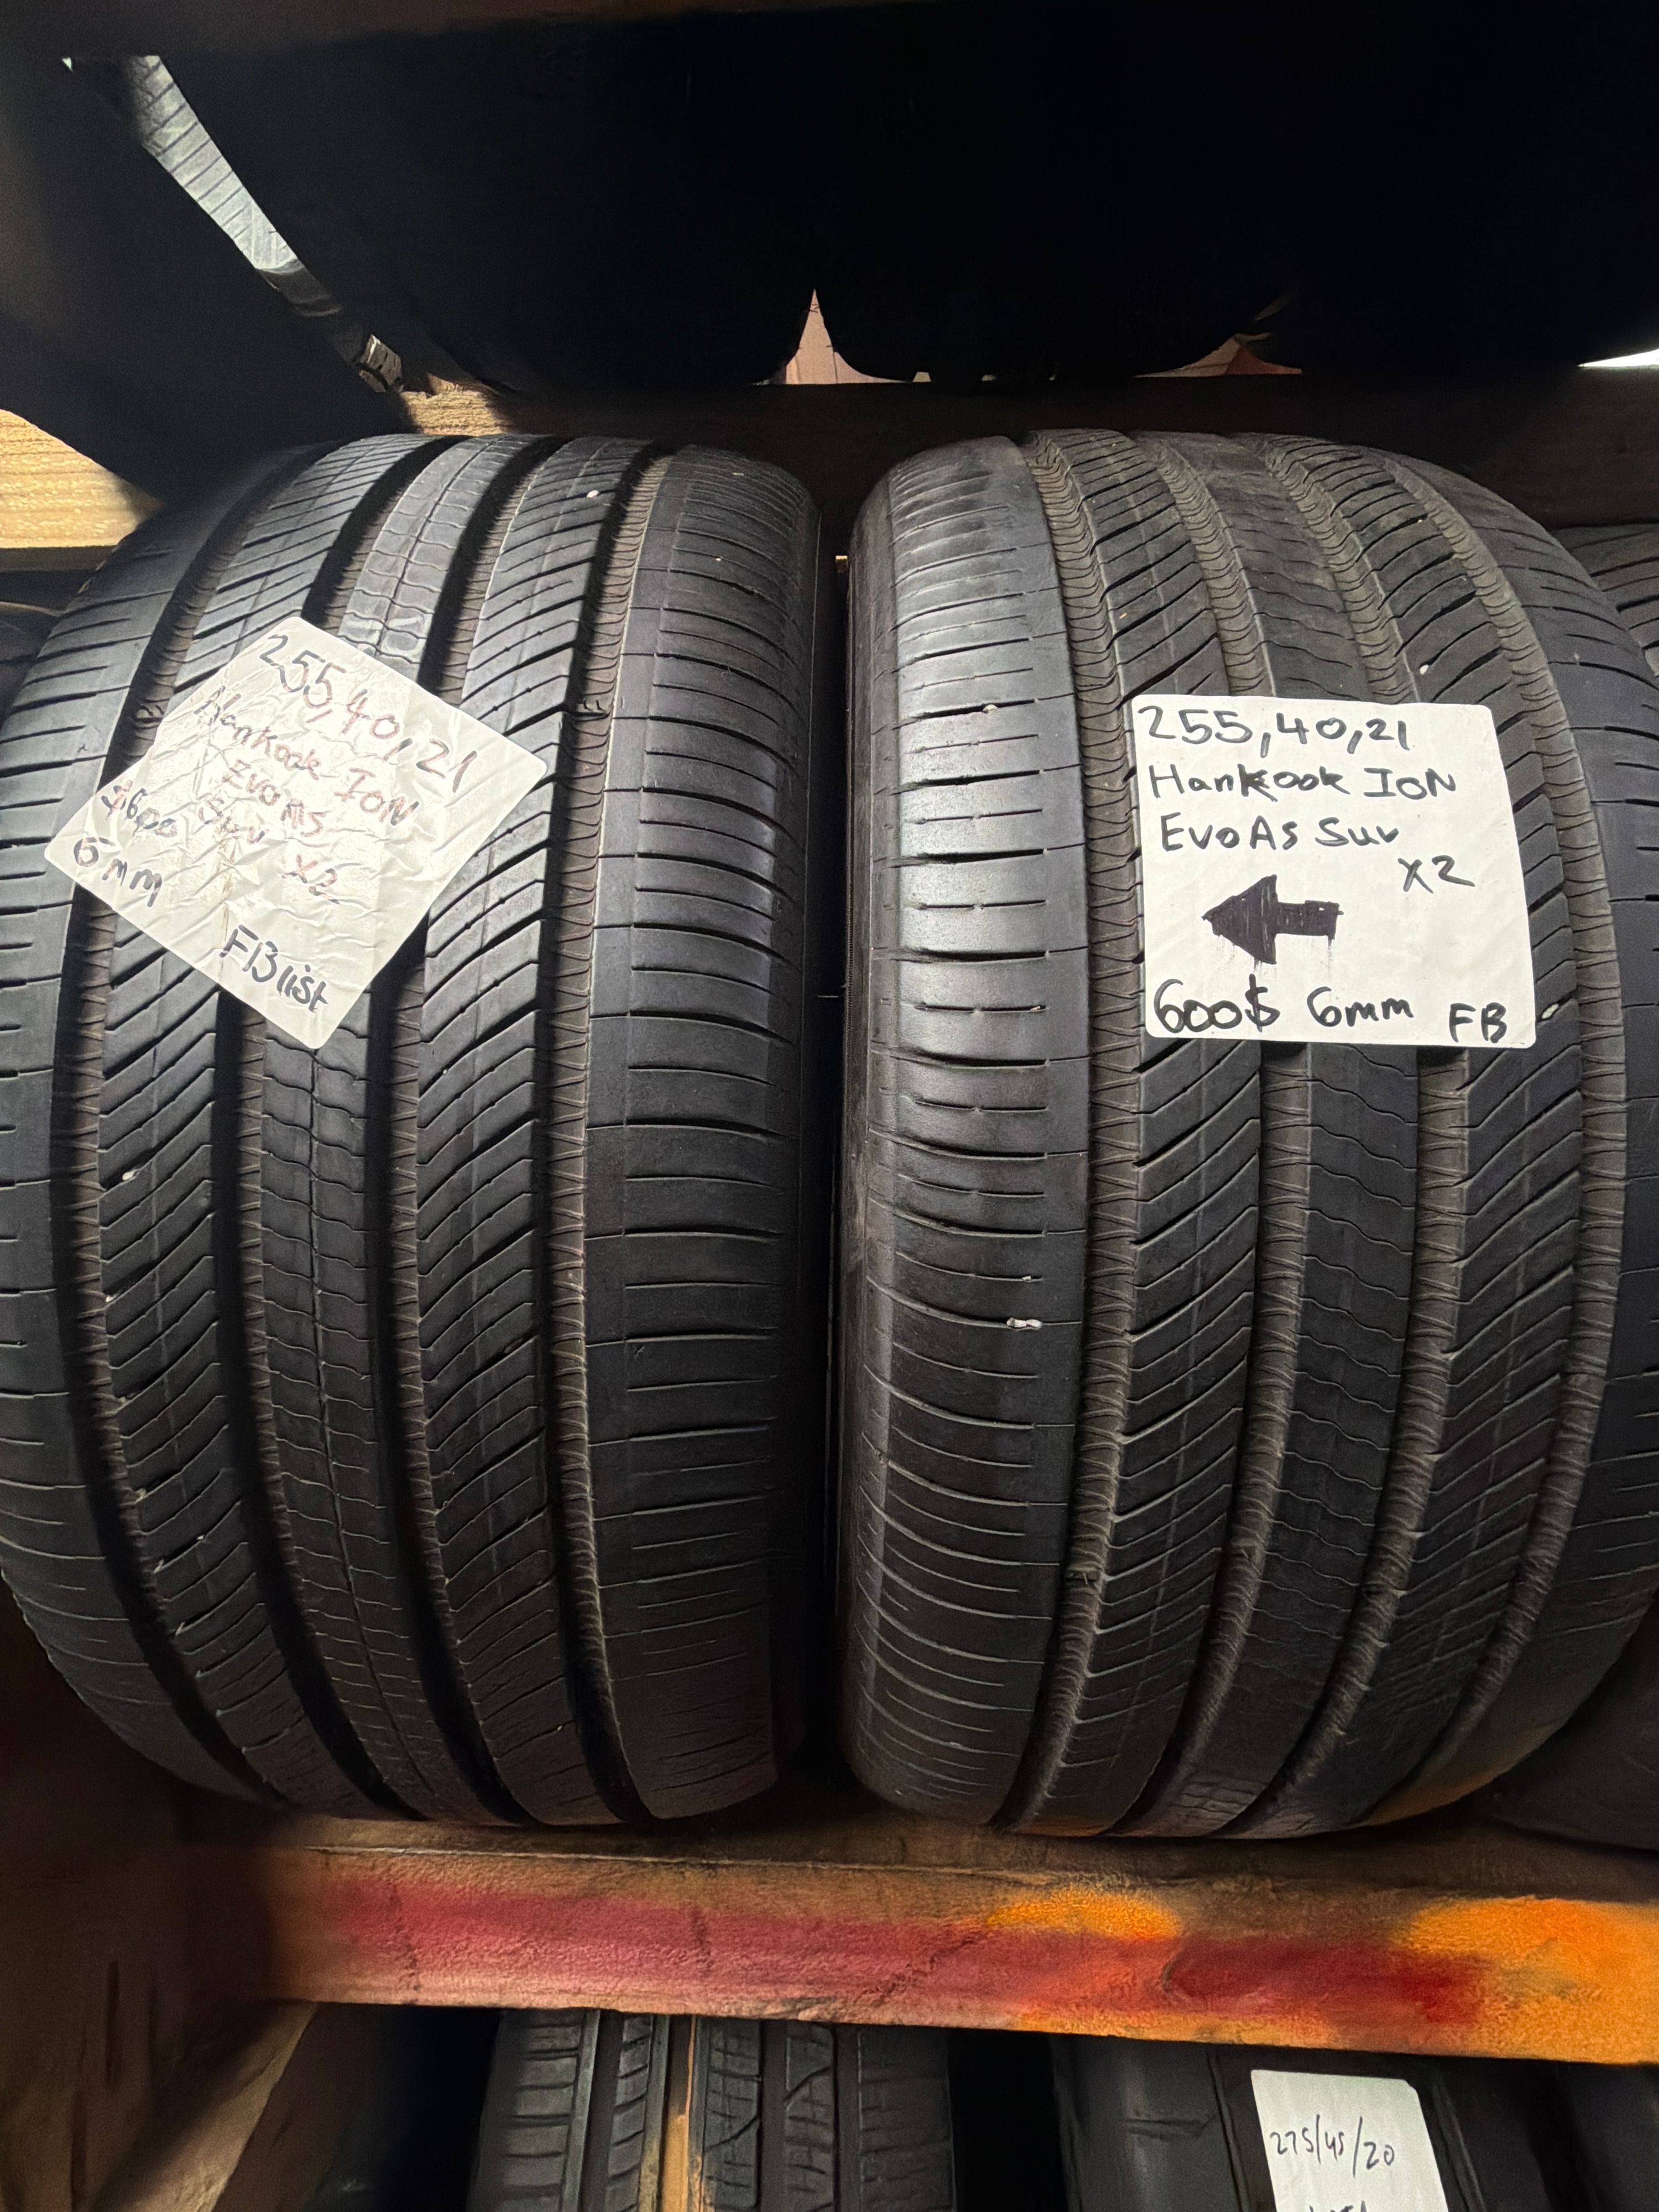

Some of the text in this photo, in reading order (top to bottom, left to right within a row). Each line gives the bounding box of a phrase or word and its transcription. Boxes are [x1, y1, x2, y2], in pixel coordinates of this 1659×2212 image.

[1138, 705, 1410, 758] 255,40,21
[1149, 763, 1457, 802] Hankook ION
[1153, 973, 1508, 1045] 600$ 6mm FB
